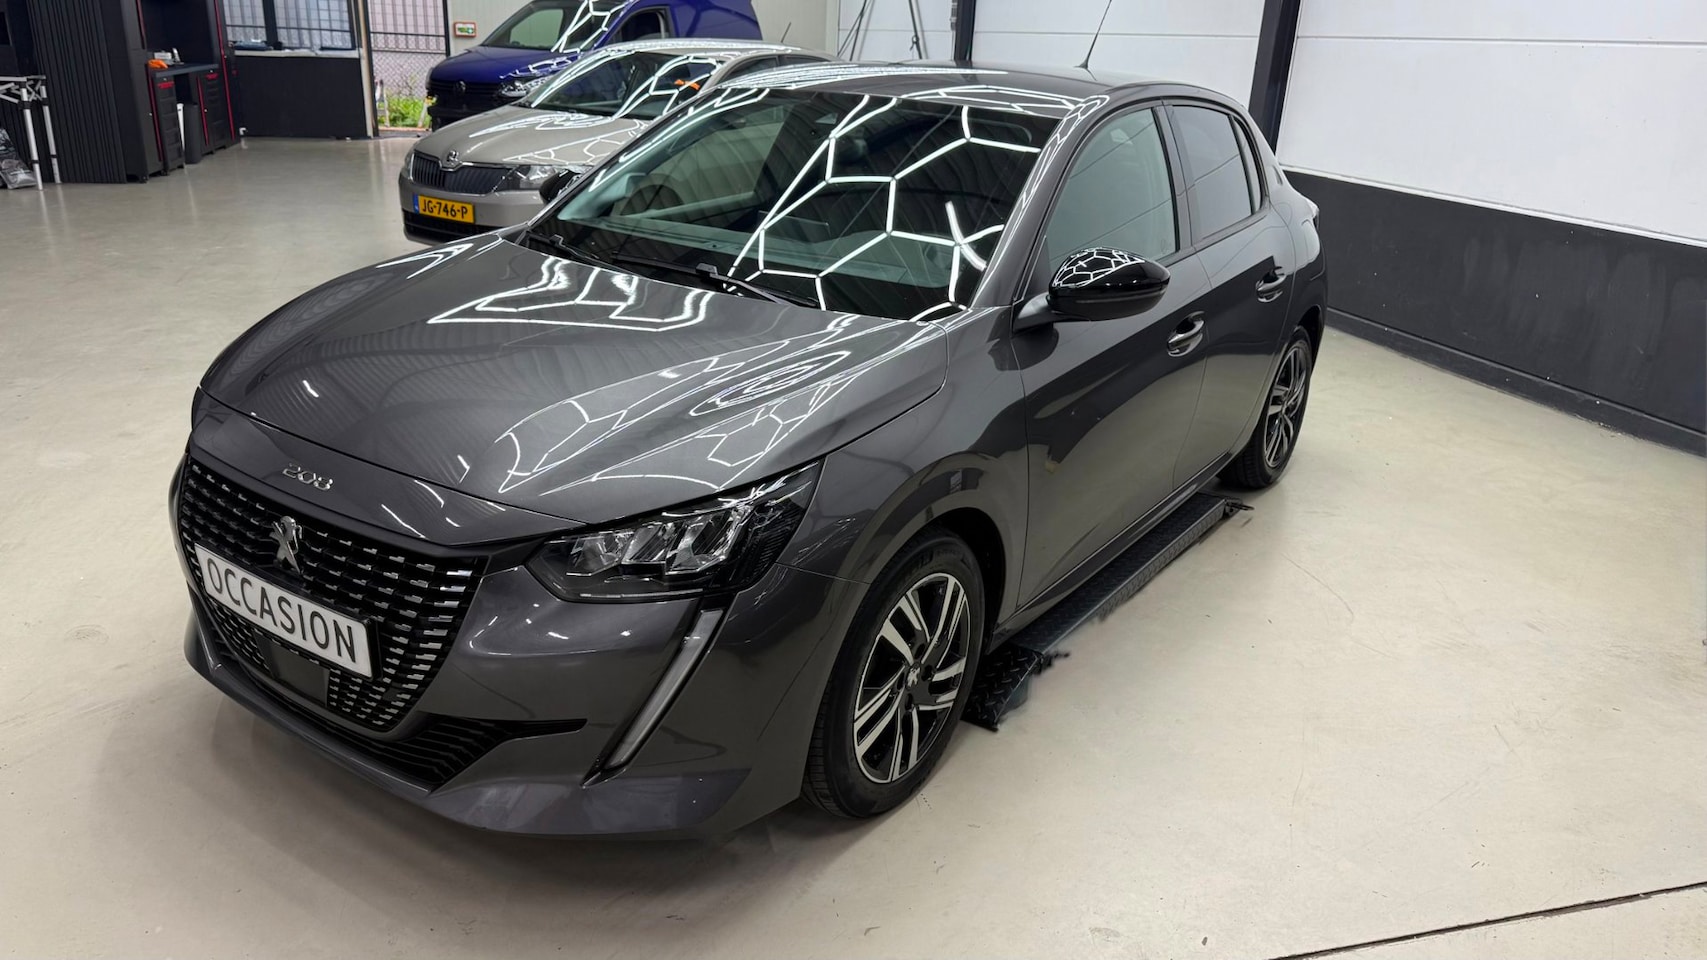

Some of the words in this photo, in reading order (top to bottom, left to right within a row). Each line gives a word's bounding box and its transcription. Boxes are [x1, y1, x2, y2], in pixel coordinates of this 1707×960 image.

[422, 199, 468, 219] JG-746-P
[282, 463, 334, 490] 208
[207, 558, 356, 663] OCCASION
